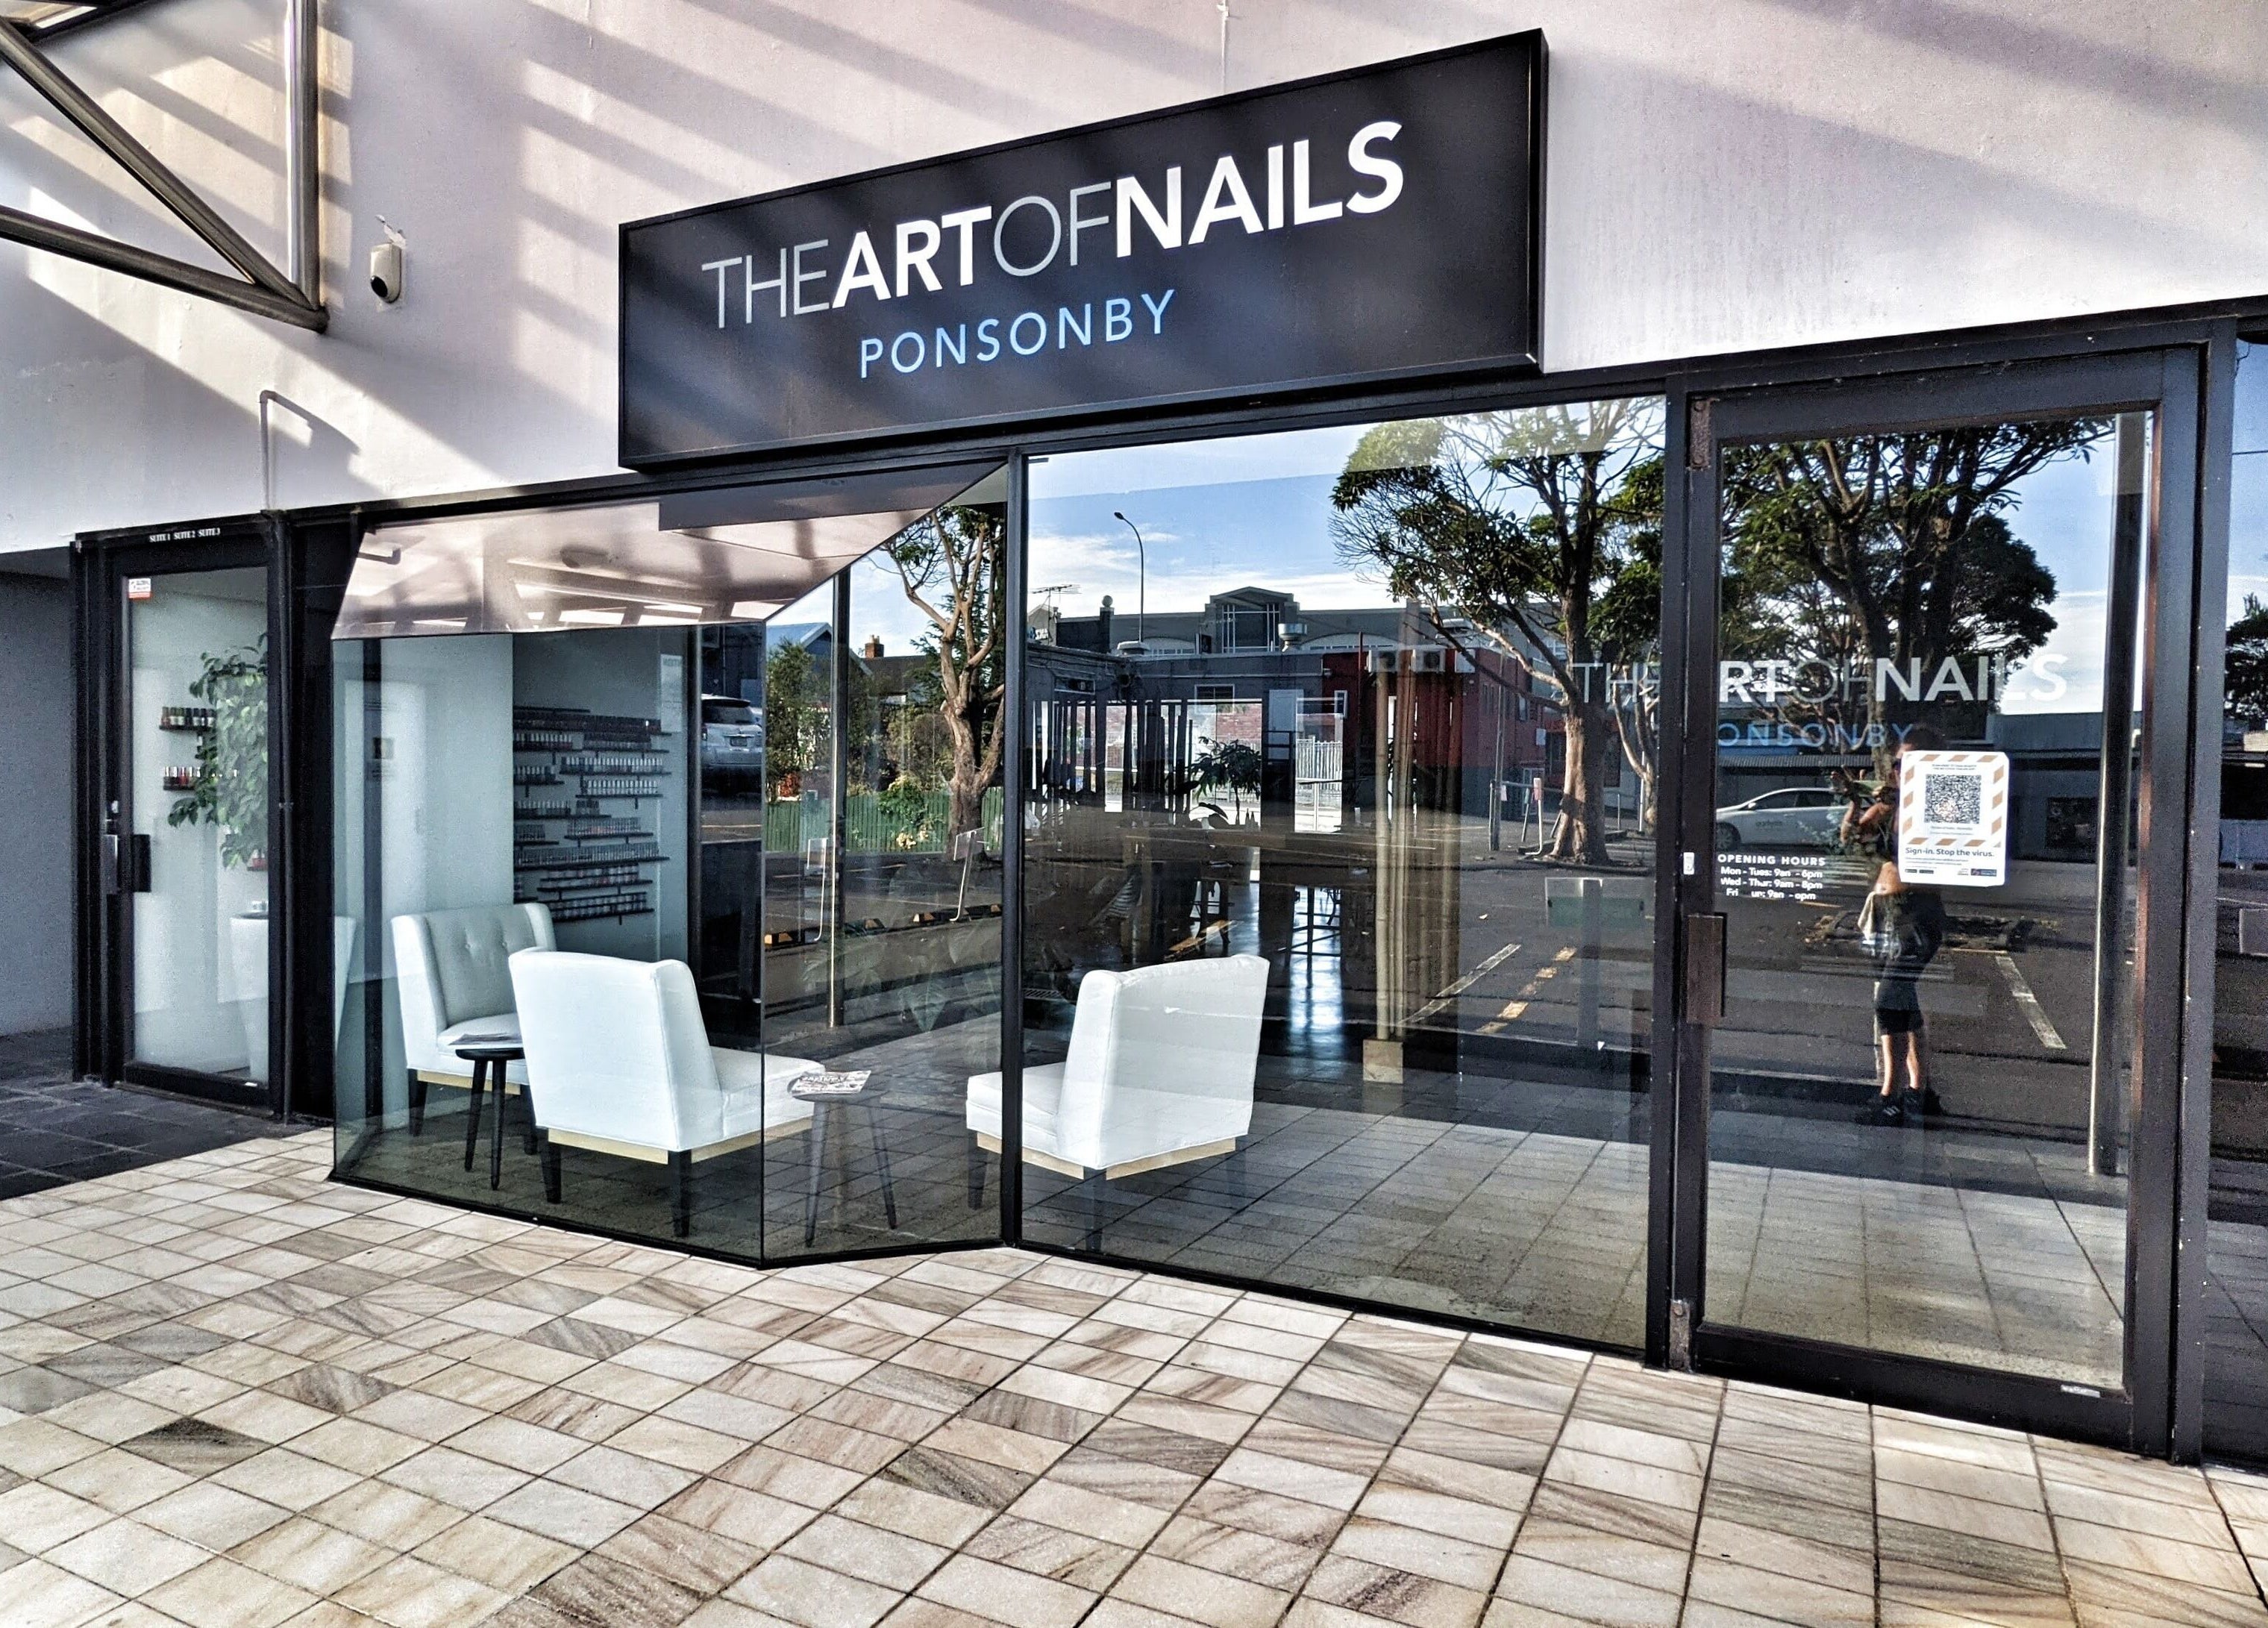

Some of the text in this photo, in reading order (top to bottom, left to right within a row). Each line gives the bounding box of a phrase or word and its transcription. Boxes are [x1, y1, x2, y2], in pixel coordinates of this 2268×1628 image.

[860, 290, 1175, 379] PONSONBY
[149, 534, 166, 542] SUITE
[174, 531, 191, 539] SUITE
[198, 529, 216, 537] SUITE
[1717, 721, 1914, 747] ONSONBY
[1905, 848, 1935, 856] Sign-in.
[1936, 848, 1955, 856] Stop
[1717, 854, 1826, 866] OPENING HOURS
[1720, 865, 1742, 874] Mon
[1748, 867, 1773, 877] Tues:
[1802, 869, 1823, 880] 6pm
[1720, 877, 1742, 886] Wed
[1774, 879, 1794, 888] 9am
[1726, 888, 1739, 896] Fri
